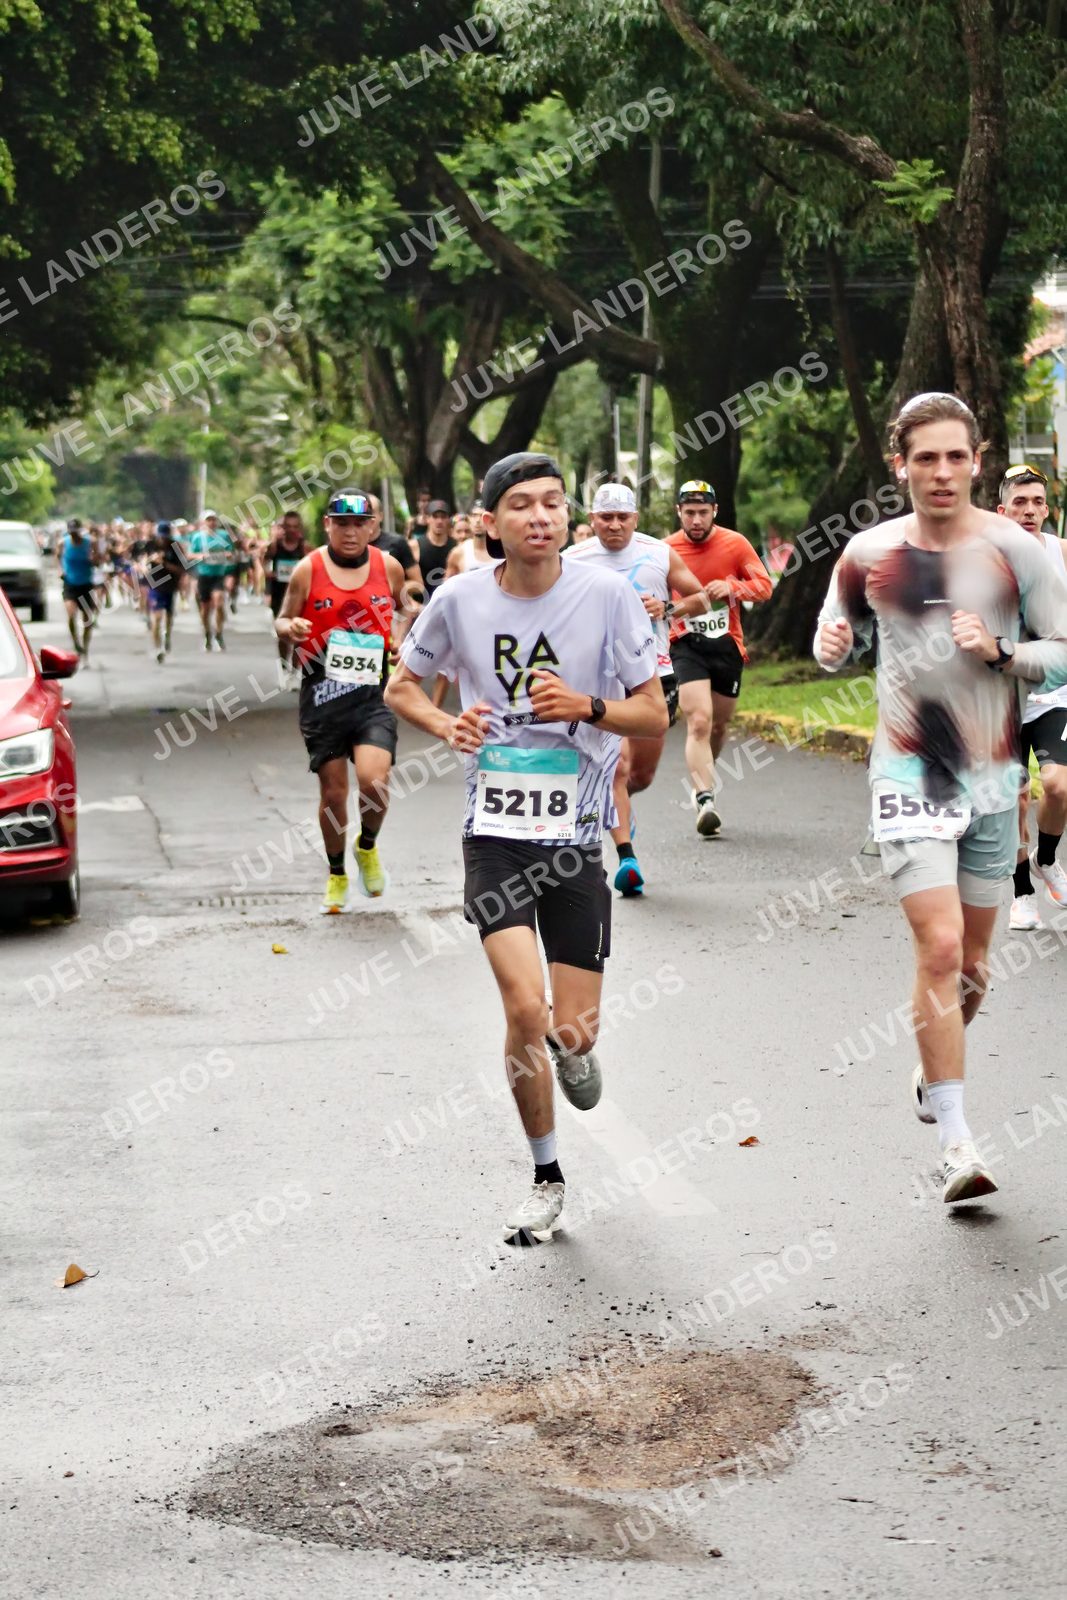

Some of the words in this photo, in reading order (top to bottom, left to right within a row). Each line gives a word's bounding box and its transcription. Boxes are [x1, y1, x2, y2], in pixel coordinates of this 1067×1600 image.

[330, 653, 377, 673] 5934
[494, 631, 560, 670] RA
[482, 786, 569, 817] 5218
